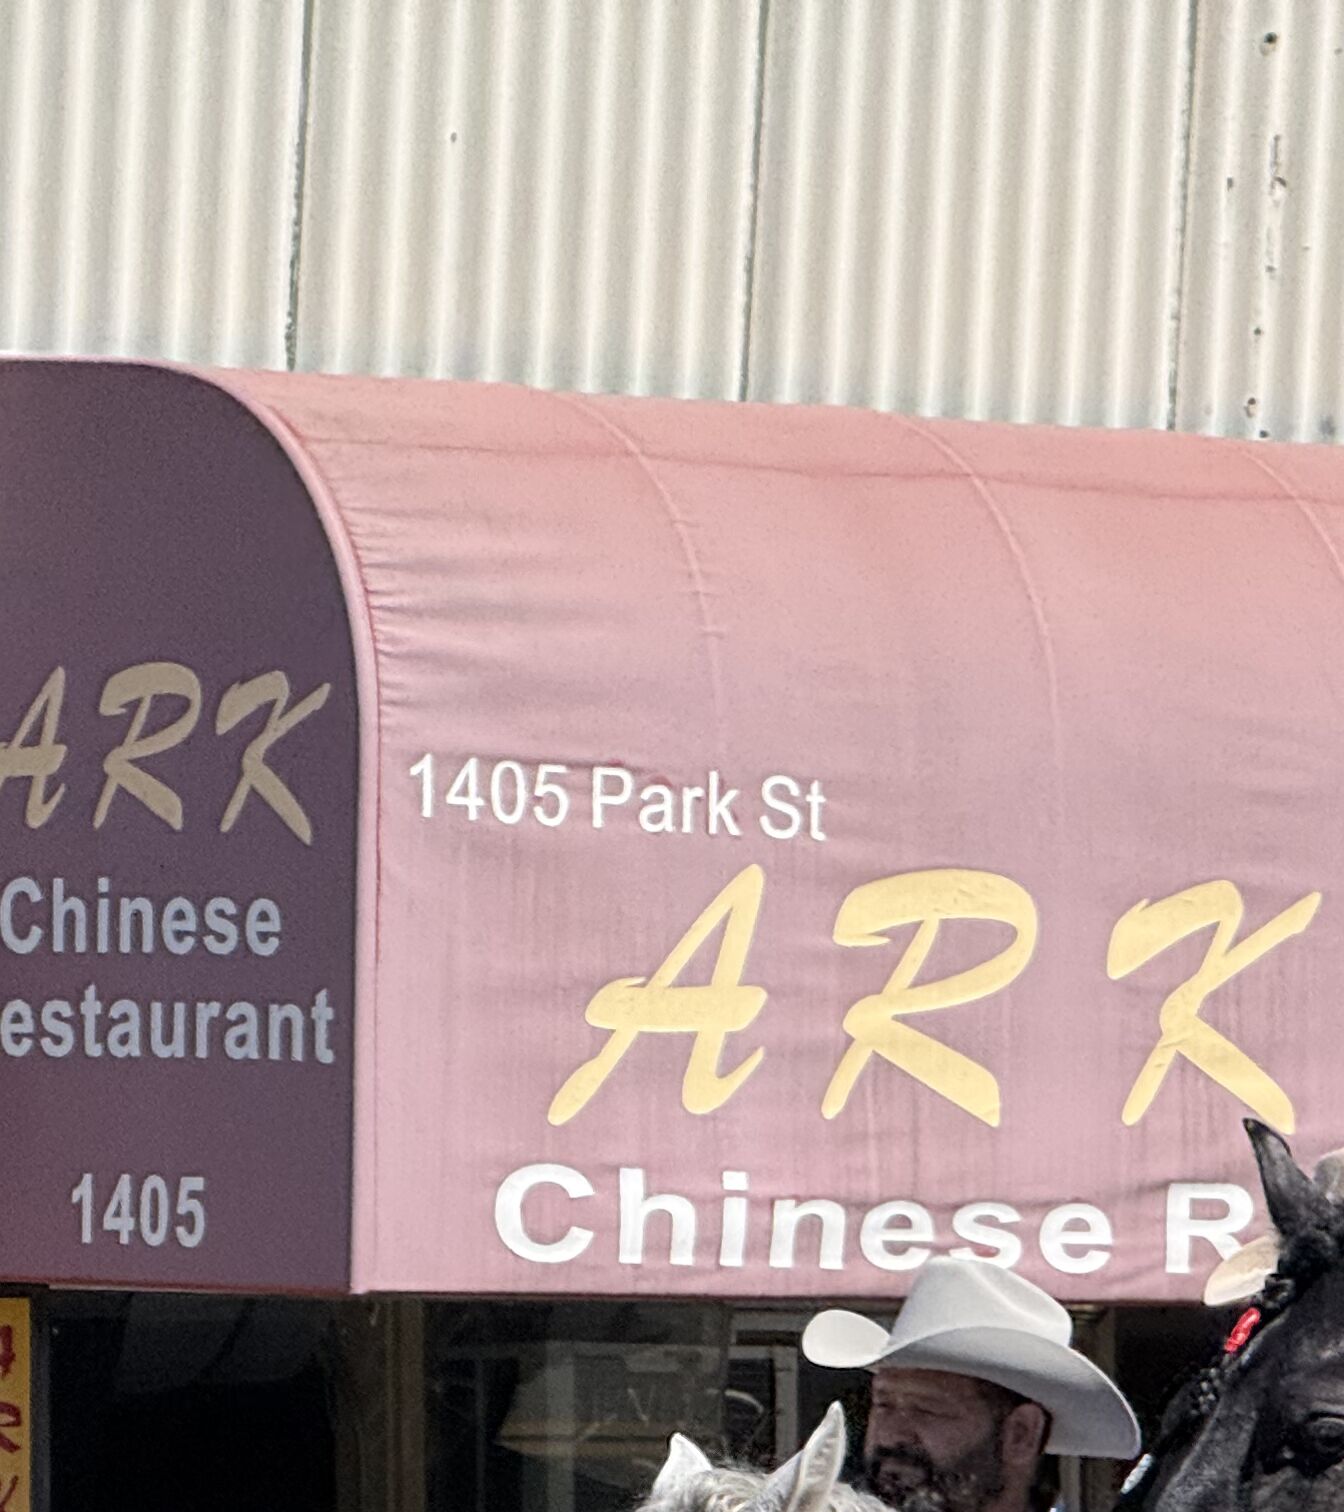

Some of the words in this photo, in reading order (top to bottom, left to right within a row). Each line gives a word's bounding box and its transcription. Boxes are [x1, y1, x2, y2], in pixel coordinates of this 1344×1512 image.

[0, 662, 331, 845] ARK
[408, 753, 570, 828] 1405
[590, 764, 743, 837] Park
[758, 774, 827, 841] St
[0, 876, 282, 955] Chinese
[548, 864, 1322, 1134] ARK
[71, 1173, 206, 1248] 1405
[494, 1162, 1113, 1274] Chinese
